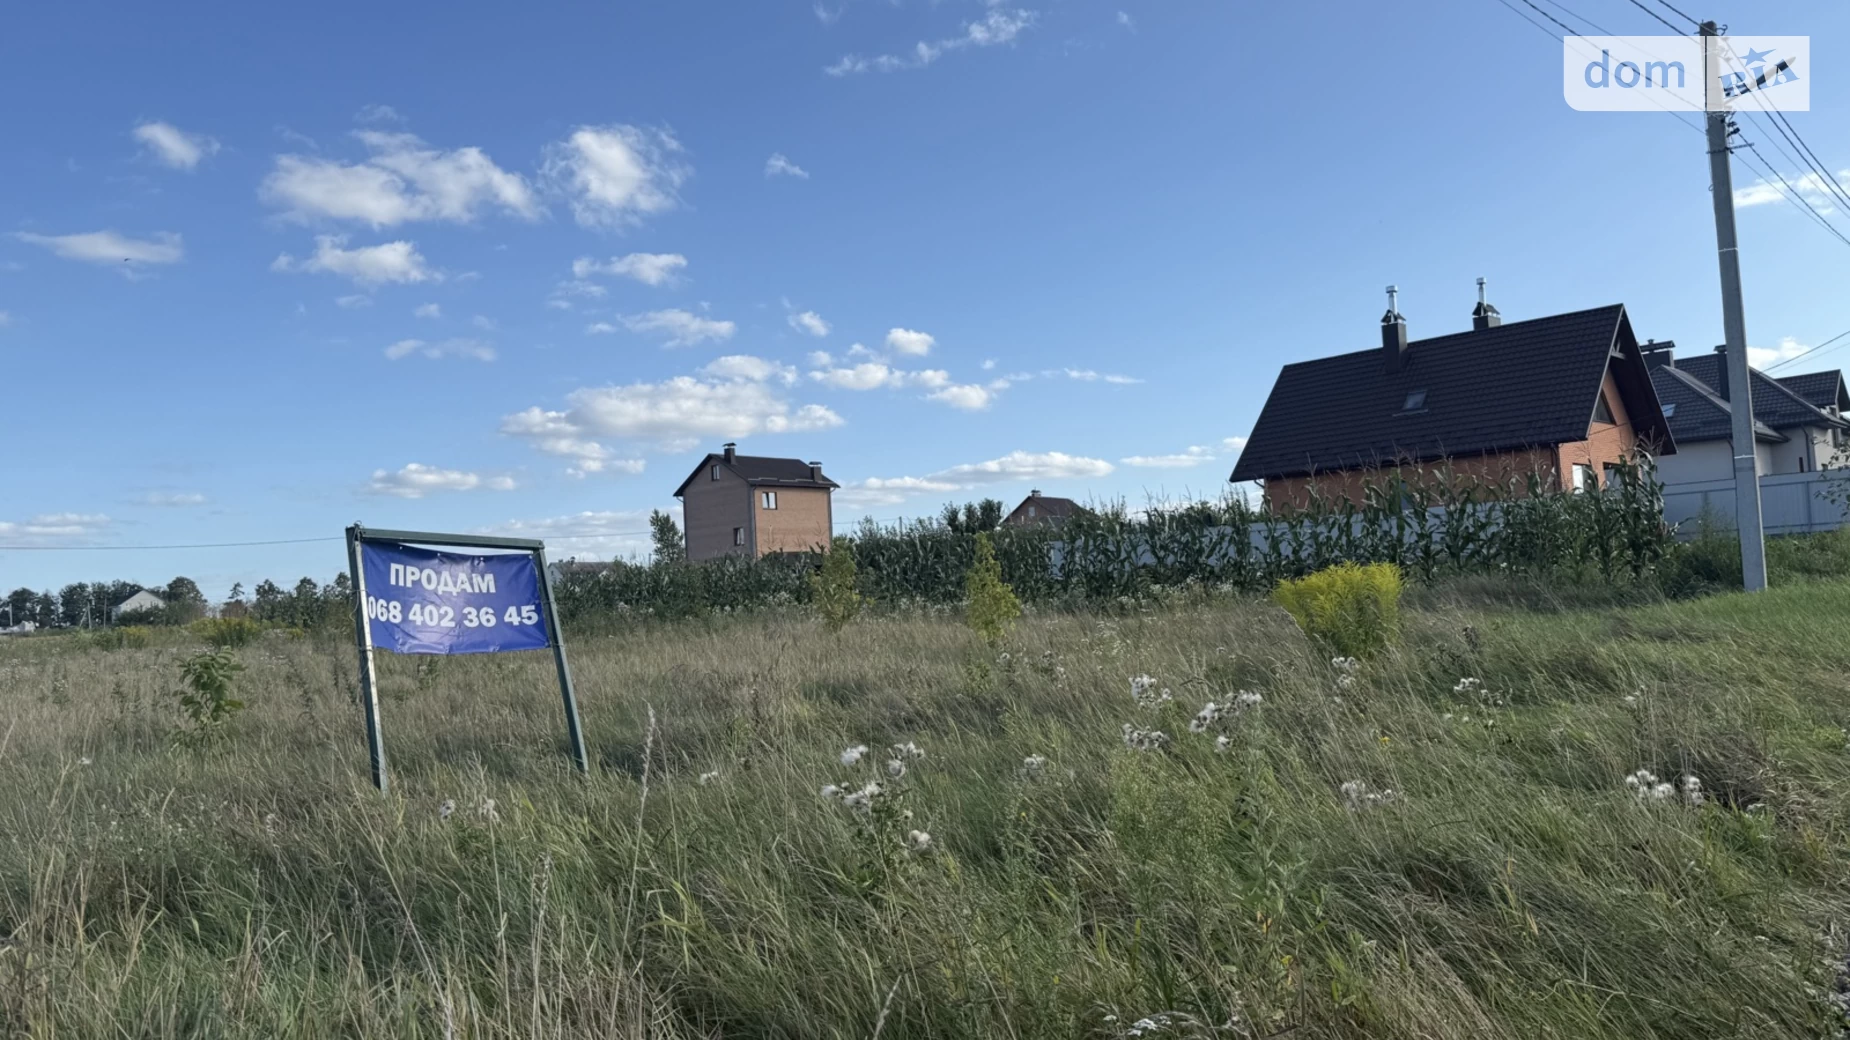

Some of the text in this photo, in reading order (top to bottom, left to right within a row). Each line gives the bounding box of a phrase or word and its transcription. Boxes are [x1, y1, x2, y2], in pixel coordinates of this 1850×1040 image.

[390, 563, 496, 596] ПРОДАМ
[368, 596, 539, 628] 068 402 36 45
